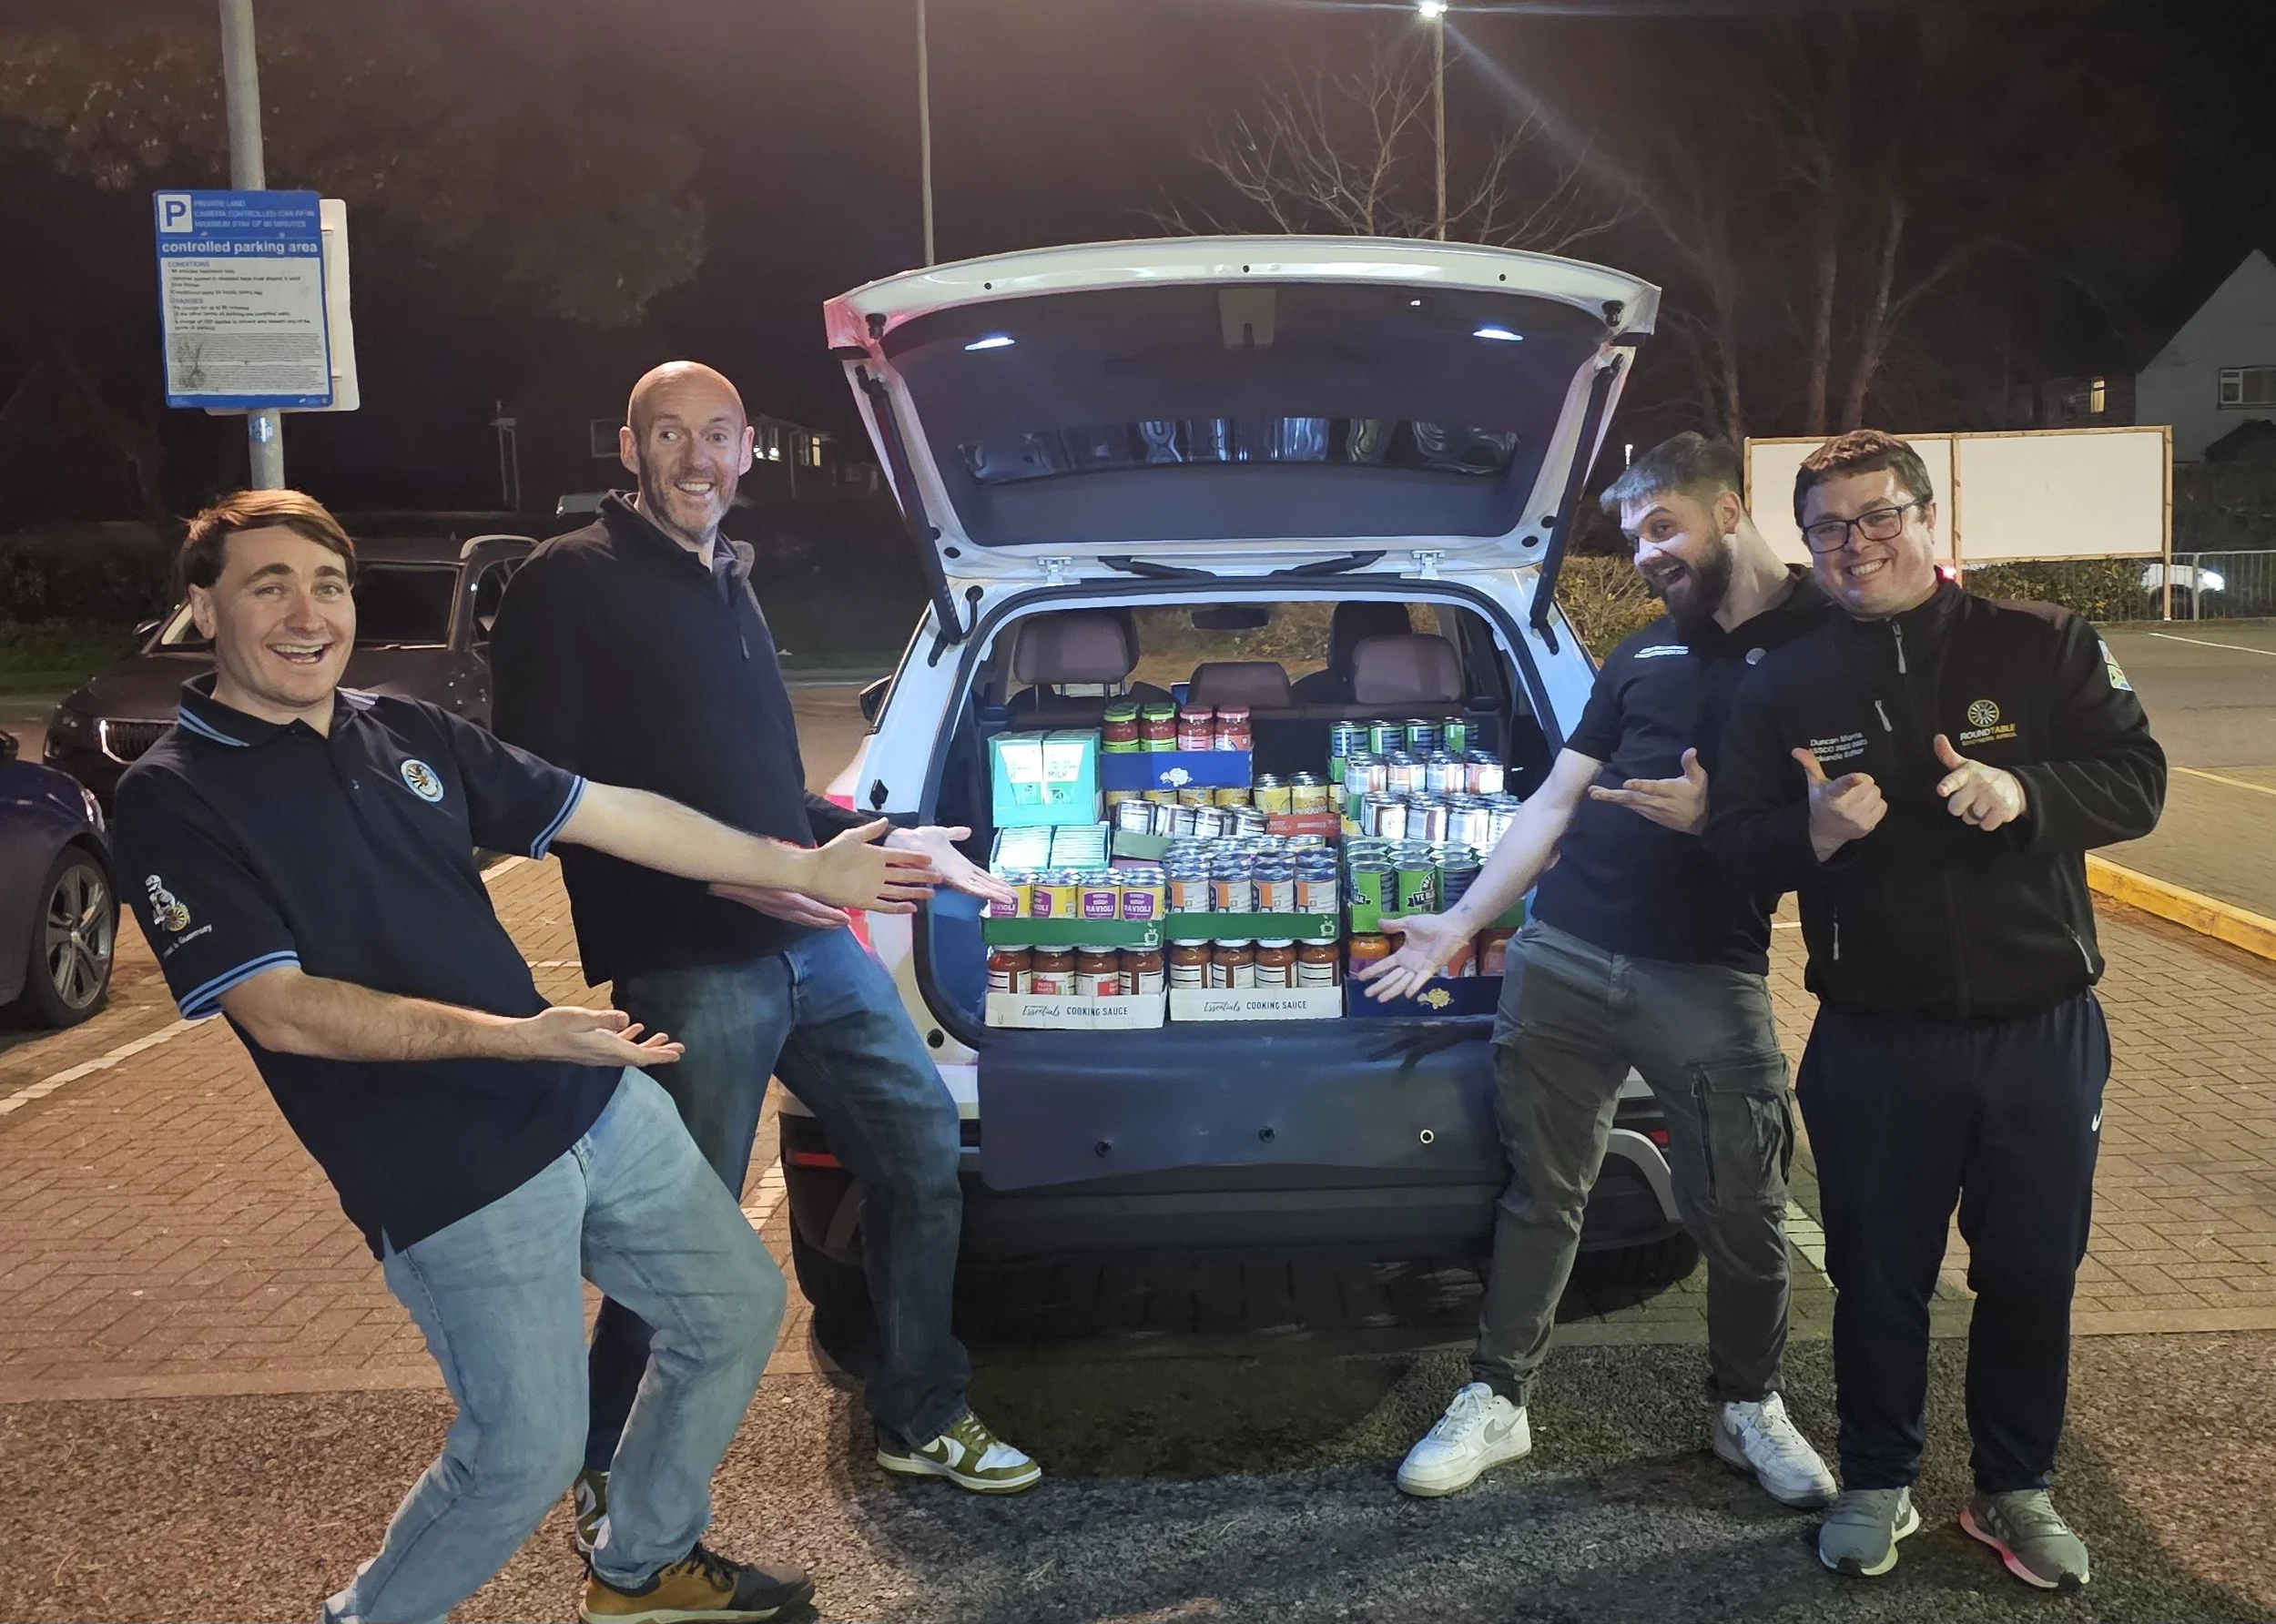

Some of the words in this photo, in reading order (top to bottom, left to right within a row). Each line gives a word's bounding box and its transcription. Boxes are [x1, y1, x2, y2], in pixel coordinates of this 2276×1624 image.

[165, 200, 187, 227] P
[161, 241, 230, 253] controlled
[234, 241, 285, 254] parking
[289, 243, 318, 253] area
[1086, 904, 1113, 912] RAVIOLI
[1123, 904, 1151, 912] RAVIOLI
[1022, 1005, 1061, 1017] Essentials
[1066, 1006, 1101, 1016] COOKING
[1102, 1006, 1128, 1015] SAUCE
[1204, 1000, 1241, 1012] Essentials
[1246, 1001, 1280, 1010] COOKING
[1282, 1000, 1307, 1010] SAUCE
